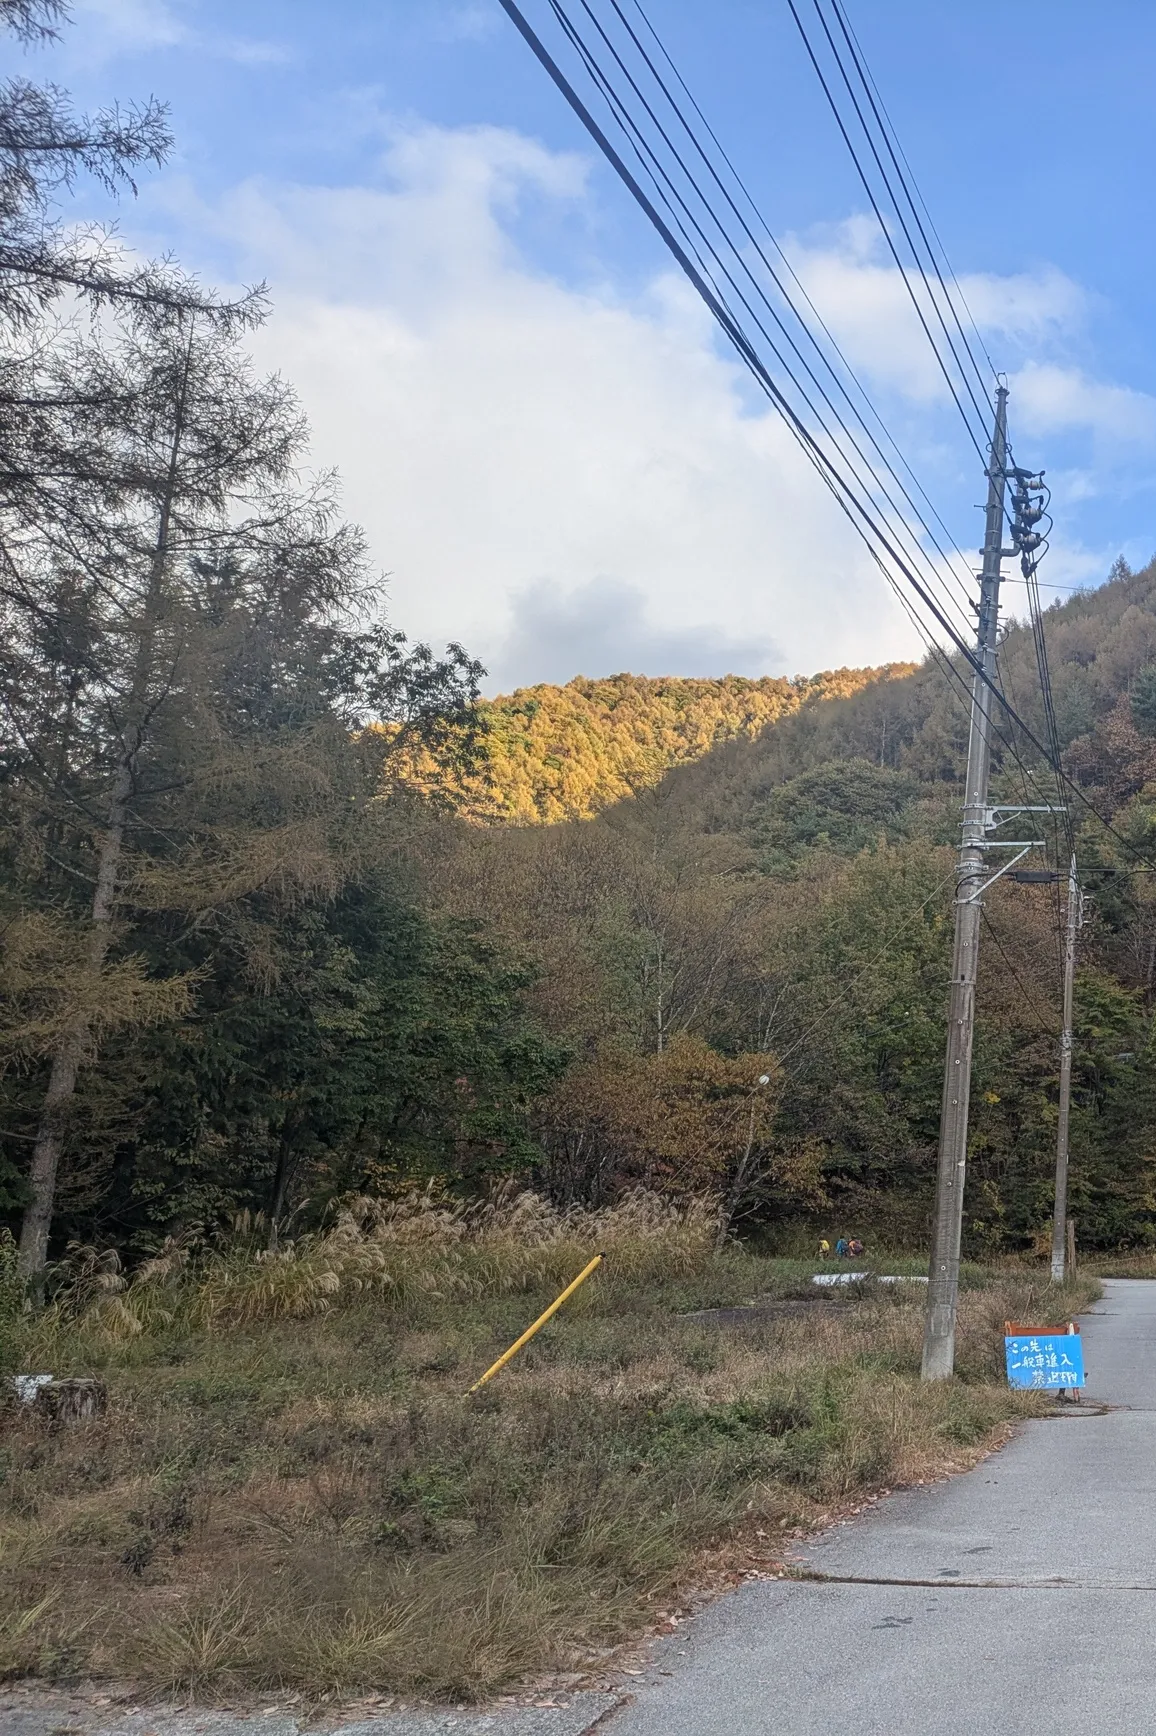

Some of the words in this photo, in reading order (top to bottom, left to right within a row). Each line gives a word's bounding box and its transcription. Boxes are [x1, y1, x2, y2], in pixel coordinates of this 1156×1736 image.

[1010, 1338, 1054, 1354] この先は
[1011, 1352, 1074, 1369] 一般車進入
